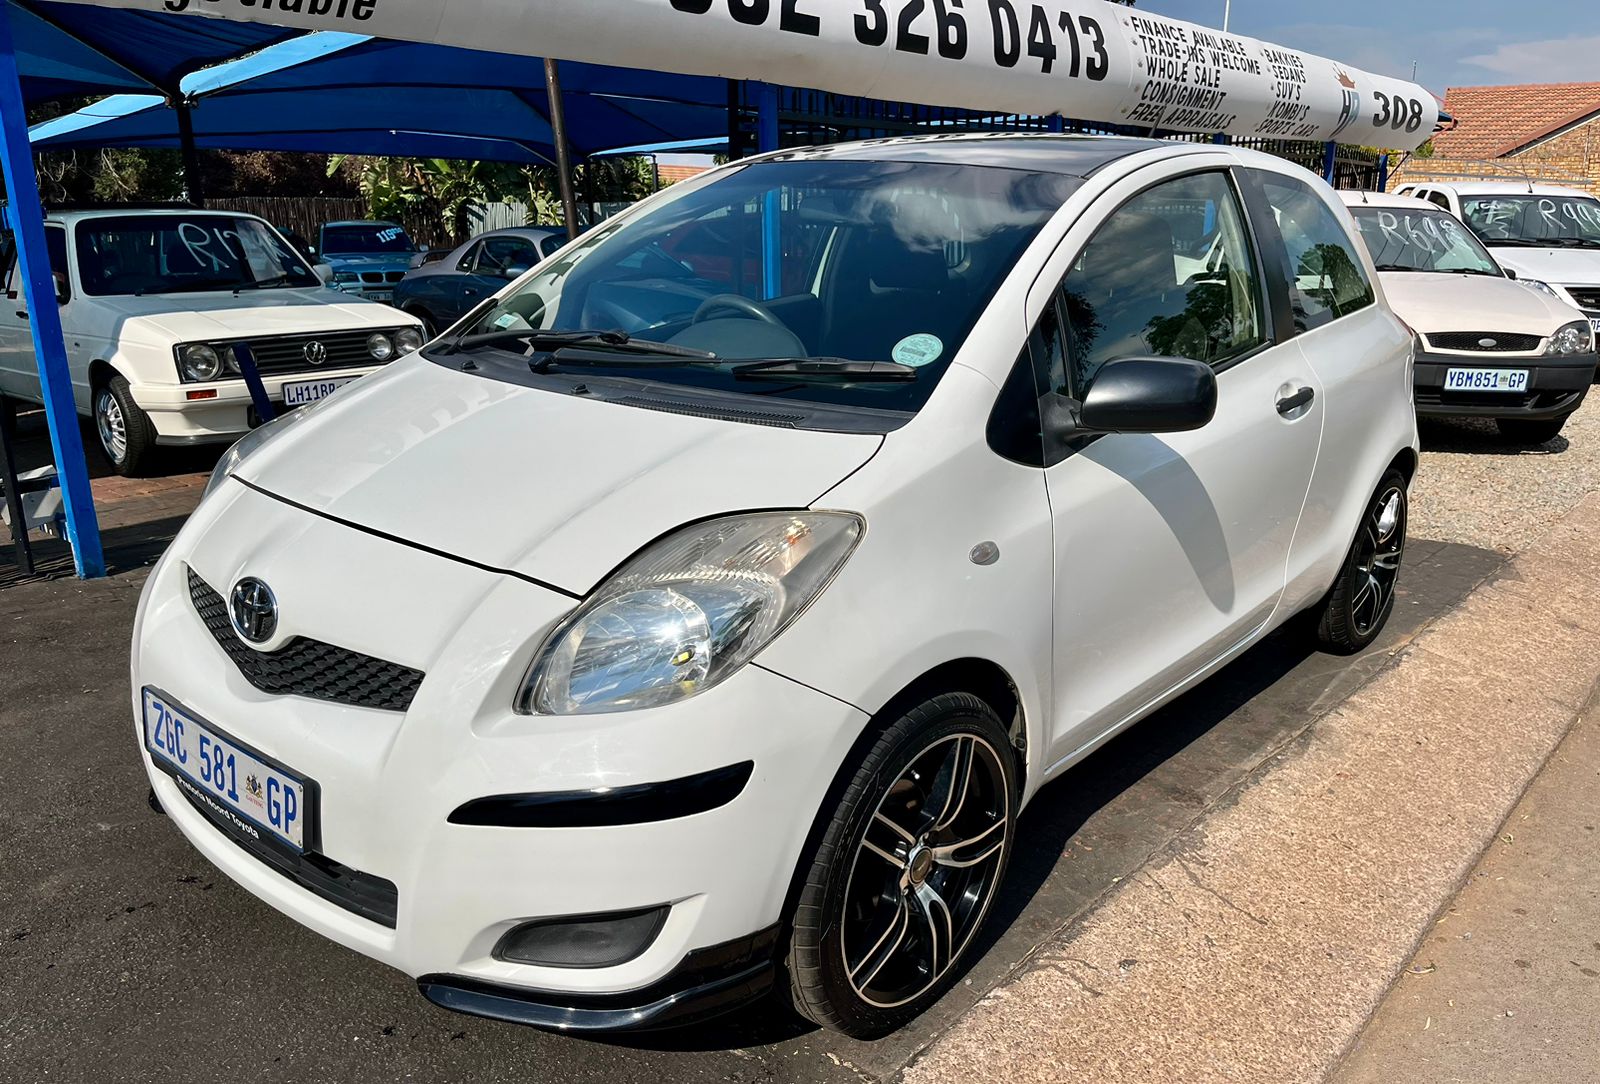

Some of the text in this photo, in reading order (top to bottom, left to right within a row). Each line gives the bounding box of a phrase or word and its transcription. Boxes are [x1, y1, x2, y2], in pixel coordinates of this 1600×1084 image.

[853, 0, 968, 60] 326
[987, 0, 1109, 81] 0413
[1130, 16, 1247, 56] FINANCE AVAILABLE
[1139, 35, 1261, 75] TRADE-INS WELCOME
[1264, 49, 1304, 69] BAKKIES
[1146, 56, 1221, 88] WHOLE SALE
[1272, 65, 1306, 84] SEDANS
[1141, 80, 1227, 111] CONSIGNMENT
[1276, 82, 1302, 101] SUV'S
[1127, 103, 1237, 130] FREE APPRAISALS
[1372, 91, 1423, 133] 308
[1255, 119, 1296, 136] SPORTS
[1449, 371, 1525, 388] YBM851 GP
[153, 702, 297, 834] ZGC 581 GP
[230, 812, 260, 839] Toyota
